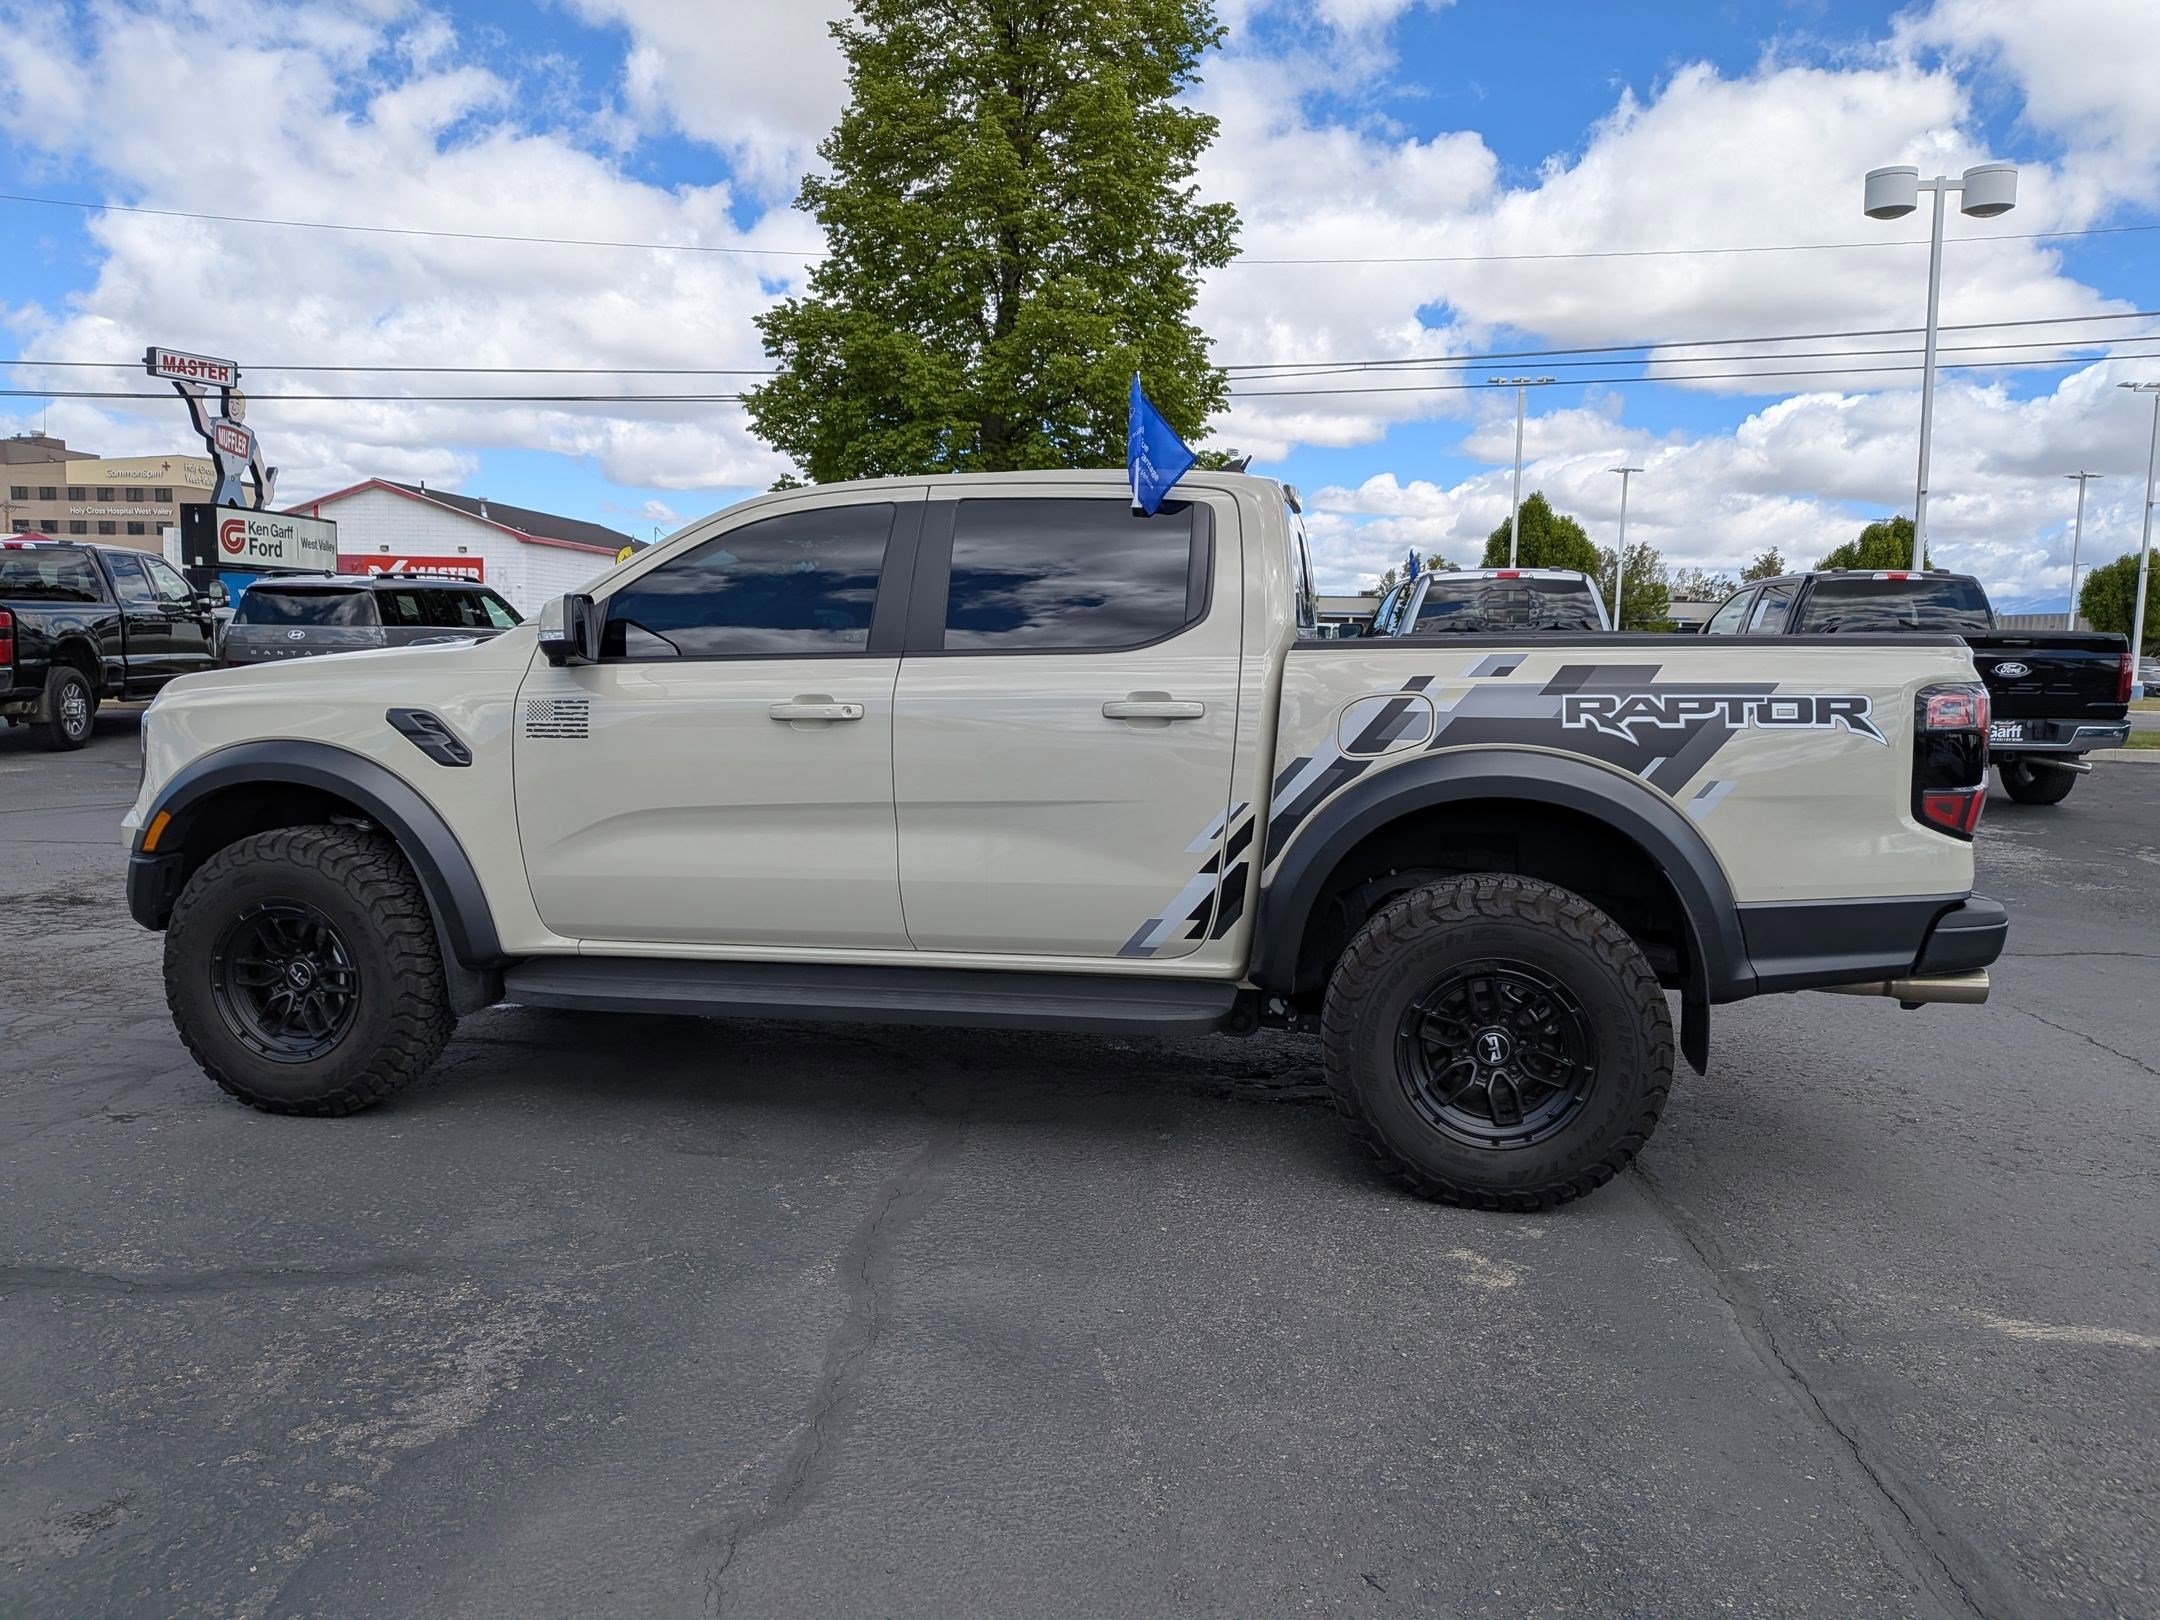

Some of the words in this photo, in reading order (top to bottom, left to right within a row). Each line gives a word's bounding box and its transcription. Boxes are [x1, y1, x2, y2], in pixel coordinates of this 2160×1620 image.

[162, 354, 228, 382] MASTER
[218, 427, 247, 455] MUFFLER
[105, 469, 163, 480] CommonSpirit
[70, 506, 85, 516] Holy
[86, 506, 106, 515] Cross
[107, 507, 134, 516] Hospital
[134, 507, 152, 516] West
[152, 507, 173, 517] Valley
[248, 520, 269, 536] Ken
[270, 523, 294, 540] Garff
[248, 537, 283, 558] Ford
[300, 537, 318, 551] West
[318, 539, 336, 555] Valley
[1562, 693, 1890, 747] RAPTOR
[1989, 724, 2023, 738] Garff
